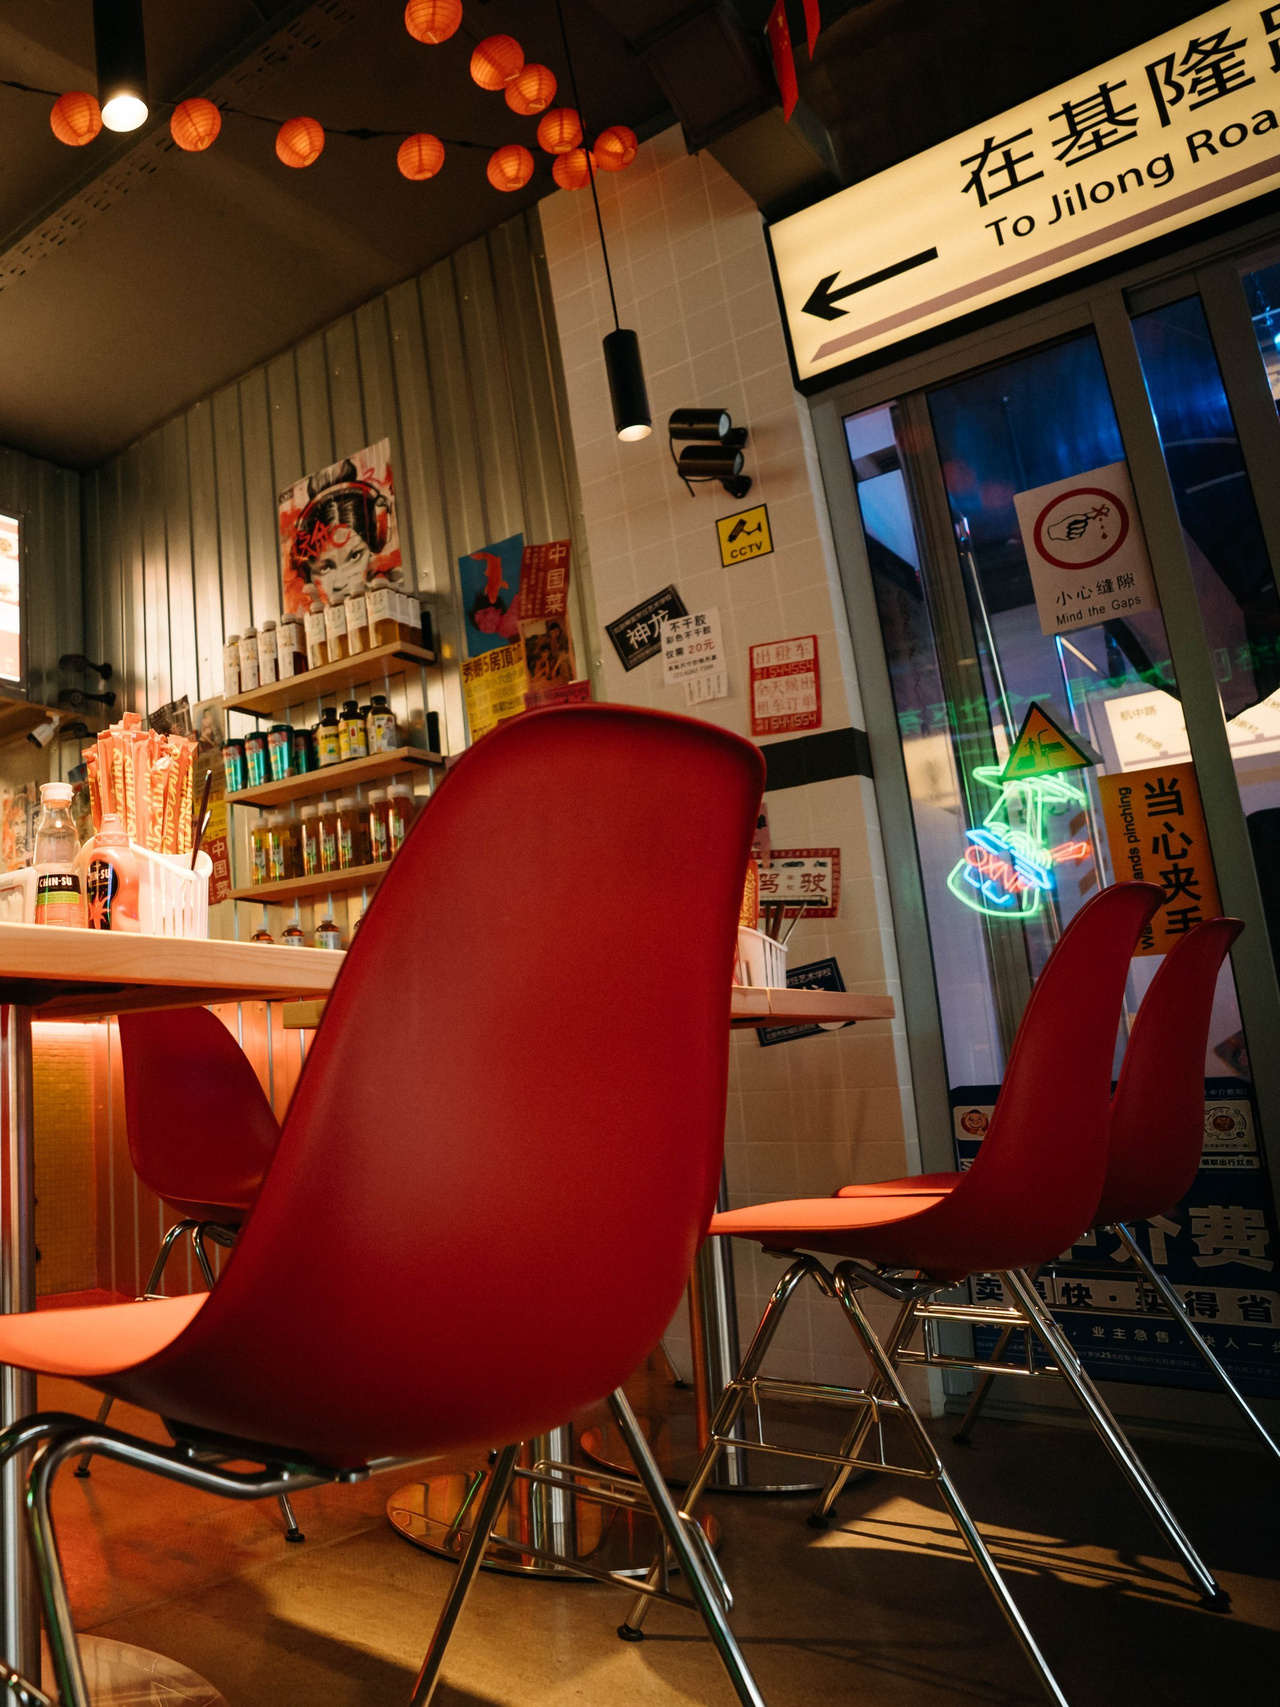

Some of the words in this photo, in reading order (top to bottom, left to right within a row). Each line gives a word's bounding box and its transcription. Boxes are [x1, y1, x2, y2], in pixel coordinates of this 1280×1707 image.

[985, 215, 1036, 247] To
[1048, 152, 1175, 226] Jilong
[730, 541, 763, 559] CCTV
[544, 543, 567, 614] 中国菜
[1056, 573, 1136, 606] 小心缝隙
[670, 614, 707, 632] 不干胶
[1056, 609, 1083, 626] Mind
[1088, 605, 1106, 617] the
[1111, 595, 1141, 610] Gaps
[688, 639, 716, 655] 20元
[1118, 786, 1141, 844] pinching
[211, 840, 231, 899] 中国菜
[1127, 847, 1144, 882] ands
[1144, 777, 1204, 935] 当心夹手
[1069, 1205, 1275, 1272] 介费
